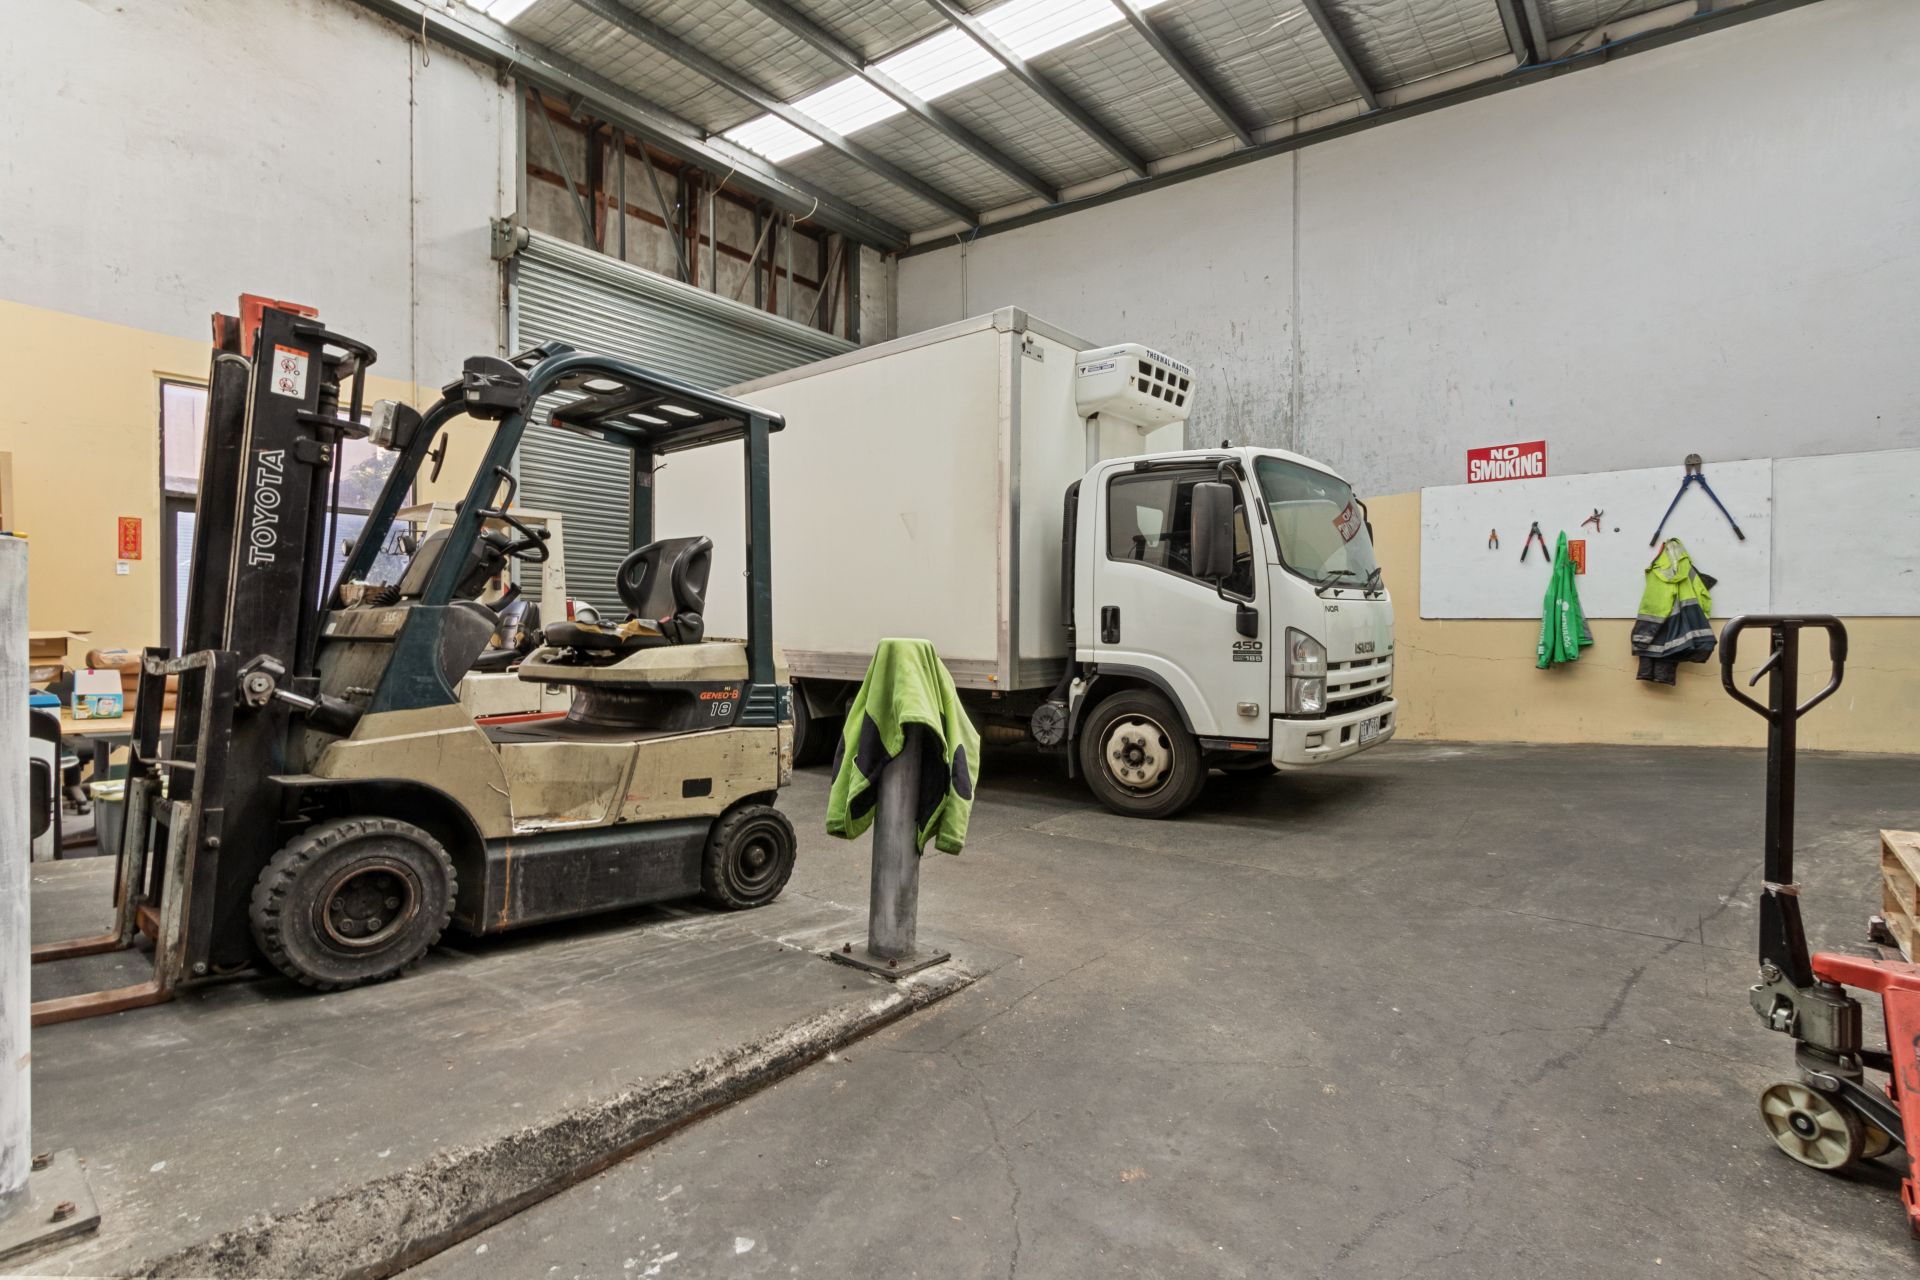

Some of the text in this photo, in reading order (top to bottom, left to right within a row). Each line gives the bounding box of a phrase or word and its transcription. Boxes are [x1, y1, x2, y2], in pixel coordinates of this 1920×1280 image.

[1146, 350, 1190, 376] THERMAL MASTER
[1490, 446, 1519, 460] NO
[1470, 452, 1543, 482] SMOKING
[248, 449, 285, 566] TOYOTA
[1232, 641, 1263, 650] 450
[1354, 641, 1376, 655] ISUZU
[710, 702, 732, 717] 18
